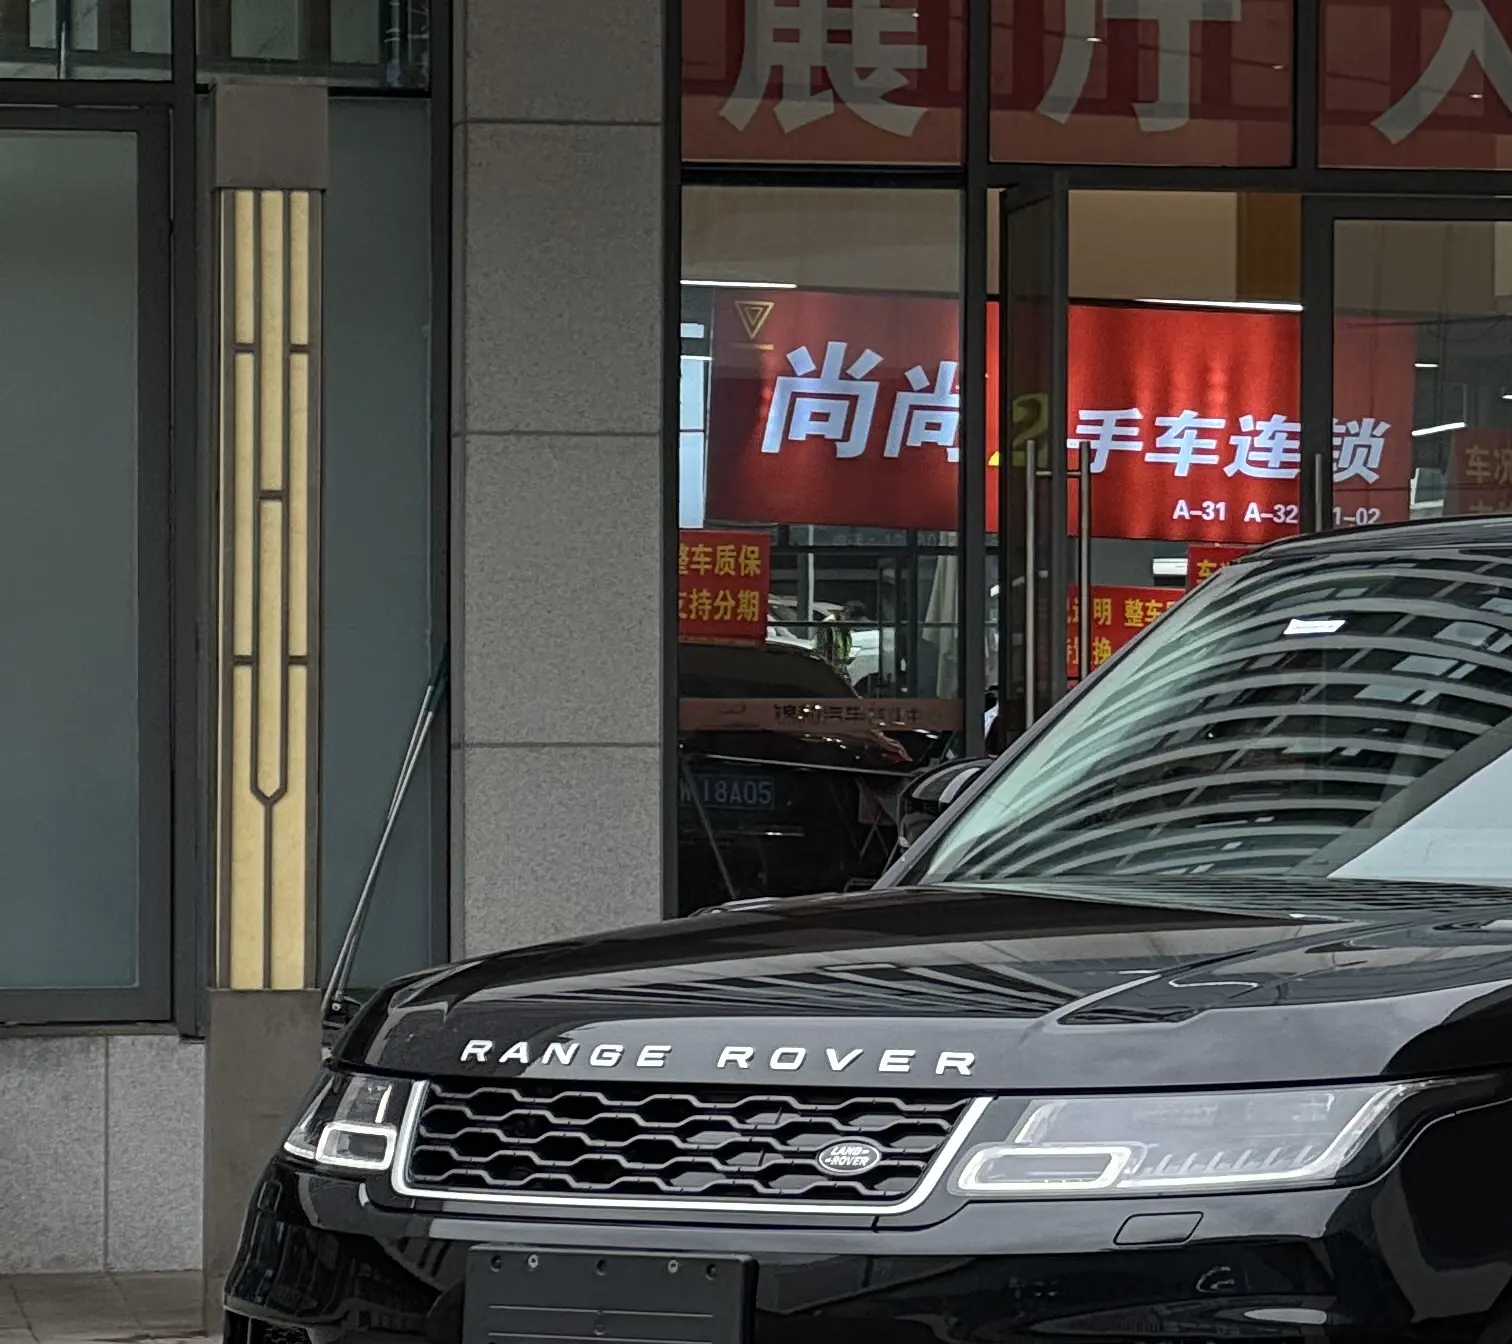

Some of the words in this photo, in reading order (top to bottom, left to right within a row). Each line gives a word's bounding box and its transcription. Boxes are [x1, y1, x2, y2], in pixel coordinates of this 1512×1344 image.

[1172, 499, 1227, 522] A-31
[1243, 501, 1299, 525] A-32
[1333, 506, 1381, 526] 1-02
[1123, 597, 1178, 627] 整车
[460, 1039, 672, 1069] RANGE
[718, 1044, 977, 1077] ROVER
[829, 1155, 870, 1167] ROVER
[830, 1145, 864, 1156] LAND
